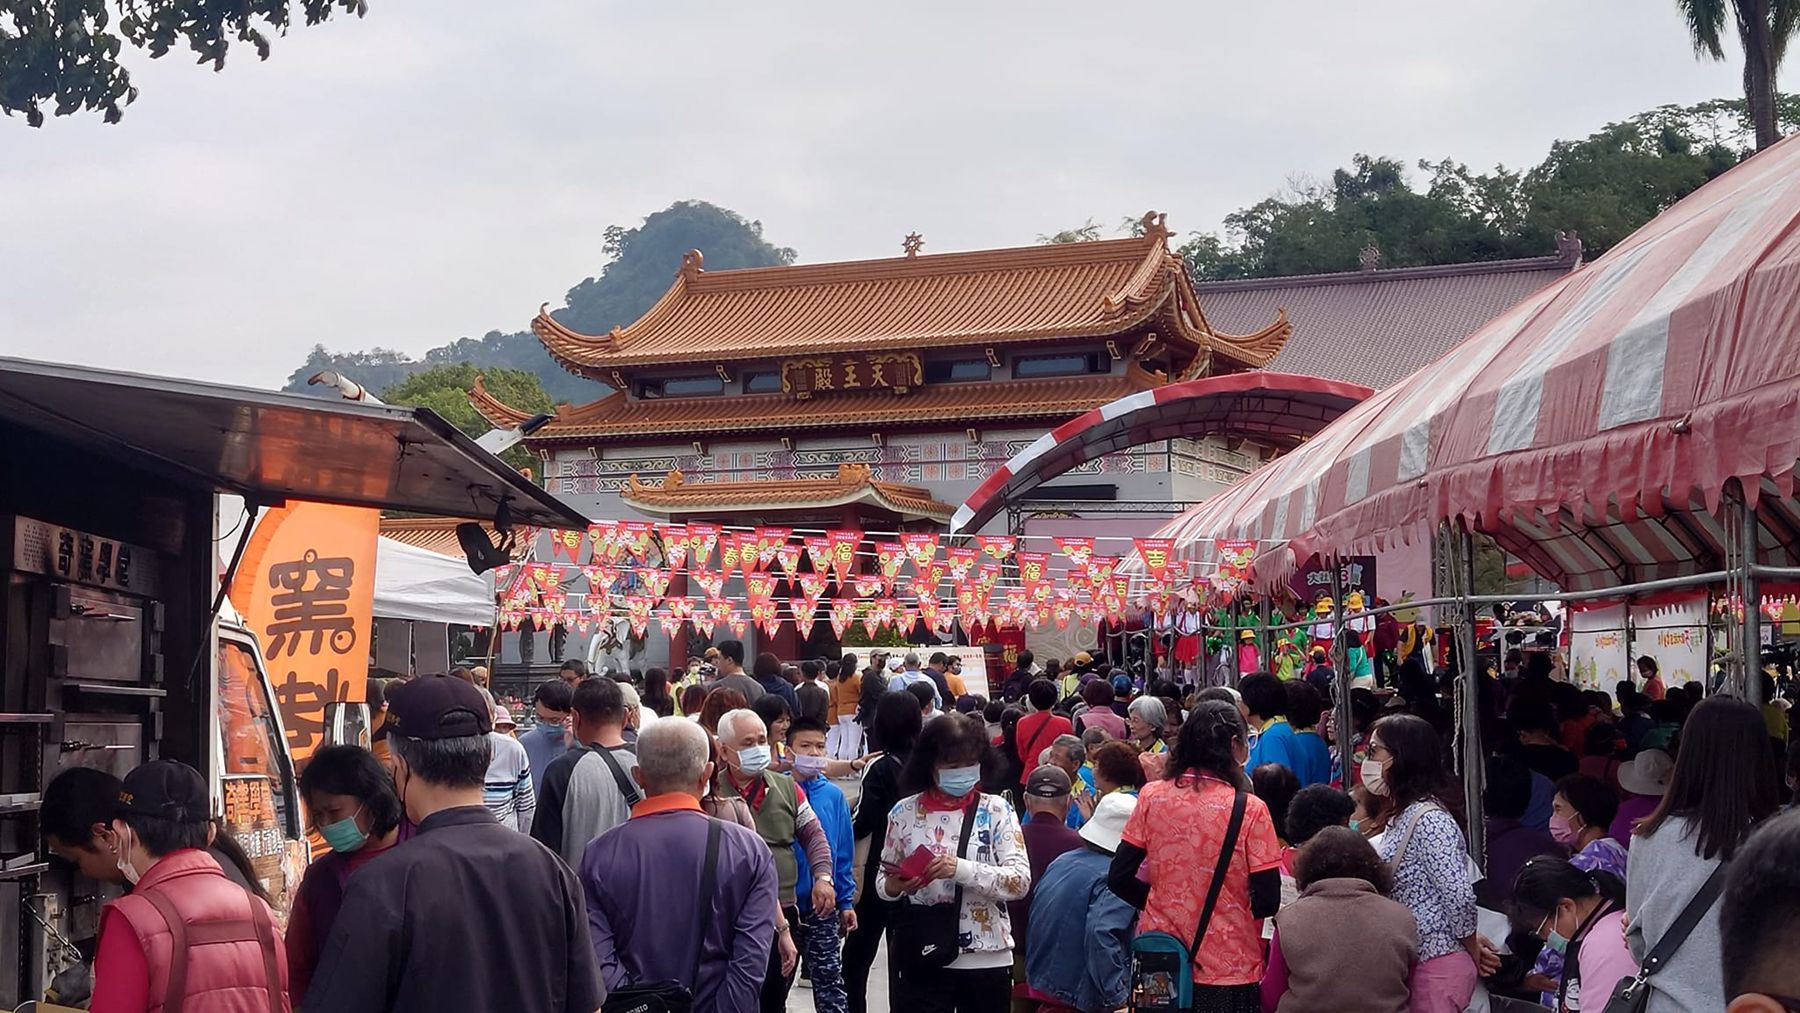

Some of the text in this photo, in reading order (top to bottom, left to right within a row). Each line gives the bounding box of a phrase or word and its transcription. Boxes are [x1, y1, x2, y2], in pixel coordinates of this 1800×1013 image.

[814, 363, 889, 391] 天王殿
[741, 542, 760, 563] 春
[835, 541, 853, 563] 福
[1144, 549, 1168, 569] 吉
[1022, 562, 1041, 582] 福
